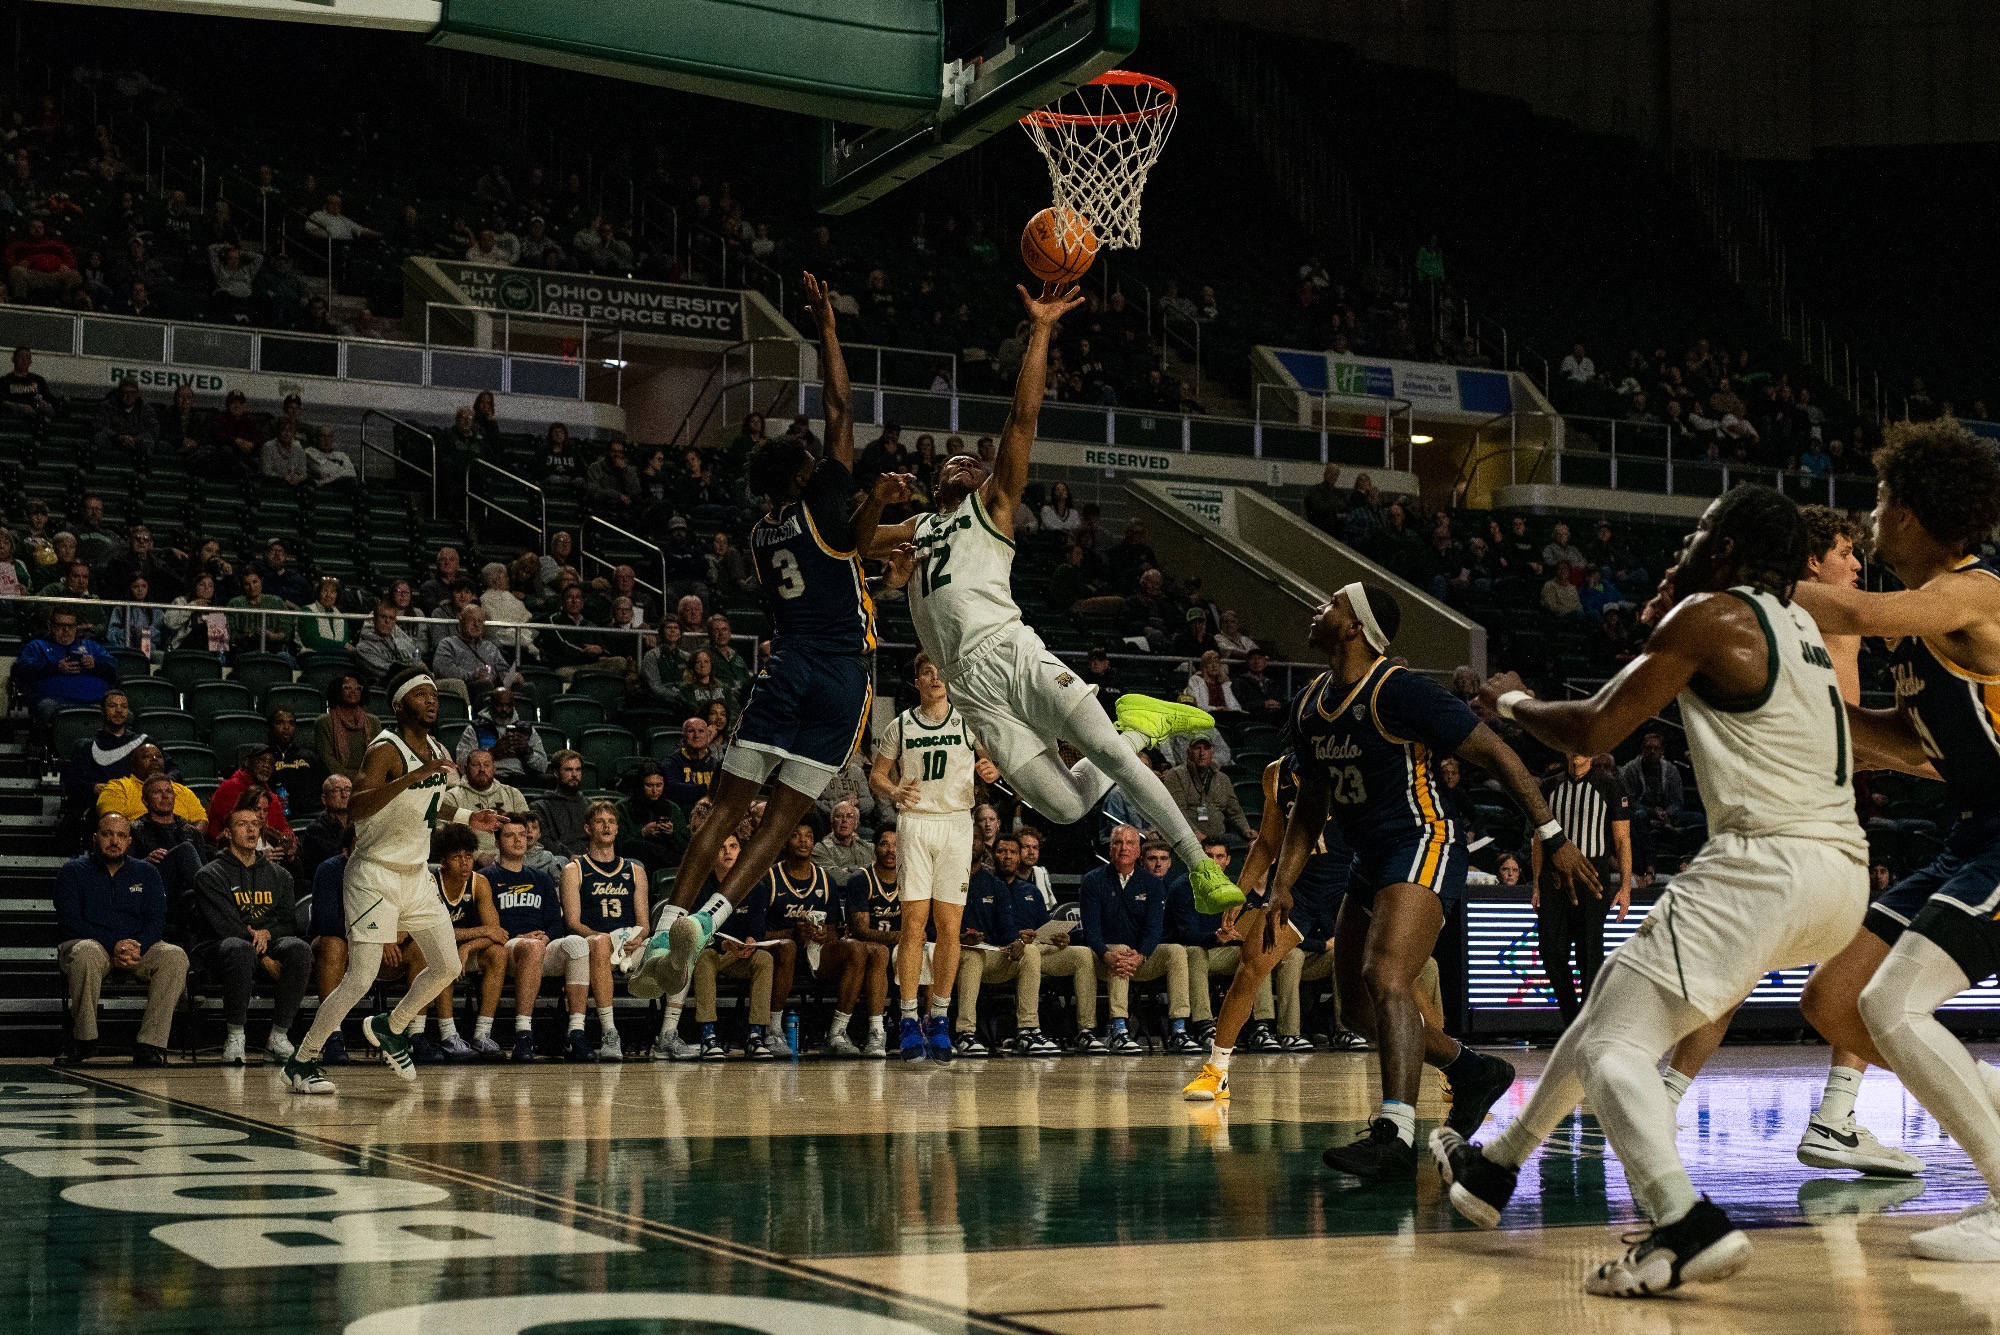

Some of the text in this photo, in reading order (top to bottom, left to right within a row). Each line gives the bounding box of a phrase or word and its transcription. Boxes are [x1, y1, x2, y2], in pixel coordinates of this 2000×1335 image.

[461, 269, 496, 284] FLY
[545, 283, 739, 315] OHIO UNIVERSITY
[546, 301, 731, 331] AIR FORCE ROTC
[111, 367, 223, 390] RESERVED
[1085, 450, 1170, 469] RESERVED
[756, 514, 802, 548] WILSON
[771, 548, 806, 600] 3
[920, 543, 952, 598] 12
[905, 734, 962, 749] BOBCATS
[1311, 733, 1363, 760] Toledo
[1828, 685, 1847, 787] 1
[922, 750, 948, 782] 10
[1328, 764, 1368, 804] 23
[423, 791, 441, 829] 4
[497, 892, 542, 910] TOLEDO
[590, 882, 629, 896] Toledo
[600, 898, 622, 918] 13
